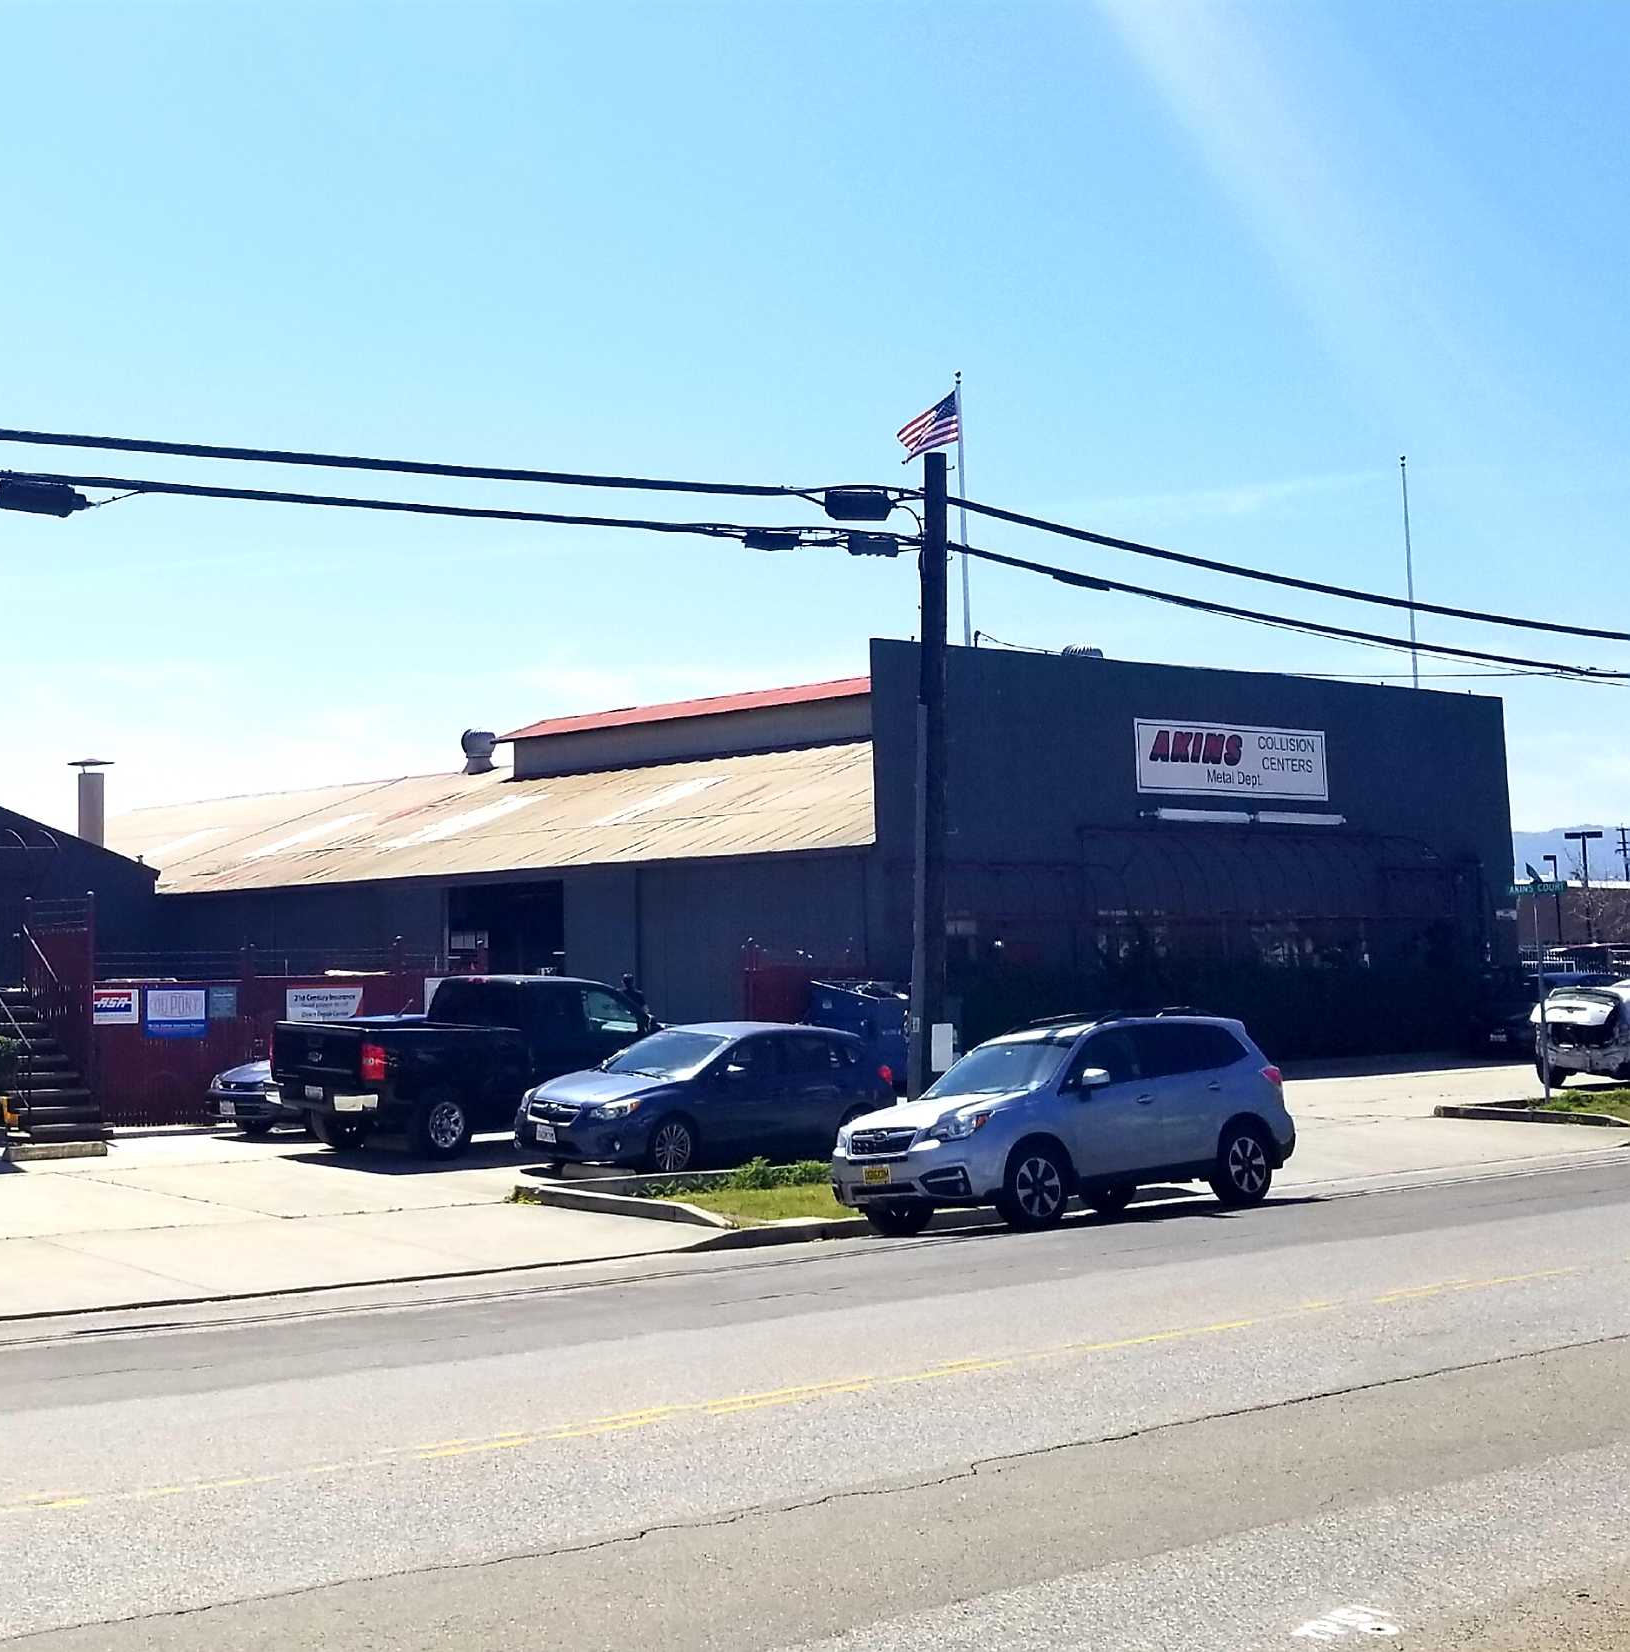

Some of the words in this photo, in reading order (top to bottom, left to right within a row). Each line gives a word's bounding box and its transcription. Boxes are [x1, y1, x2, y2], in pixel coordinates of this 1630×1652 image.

[1149, 730, 1243, 766] AKINS
[1257, 735, 1316, 753] COLLISION
[1261, 757, 1313, 773] CENTERS
[1206, 768, 1235, 785] Metal
[1237, 771, 1264, 788] Dept.
[1509, 886, 1534, 894] AKINS
[1537, 882, 1565, 892] COURT
[97, 997, 130, 1009] ASA
[294, 994, 306, 1002] 21st
[306, 993, 328, 1002] Century
[329, 993, 356, 1001] Insurance
